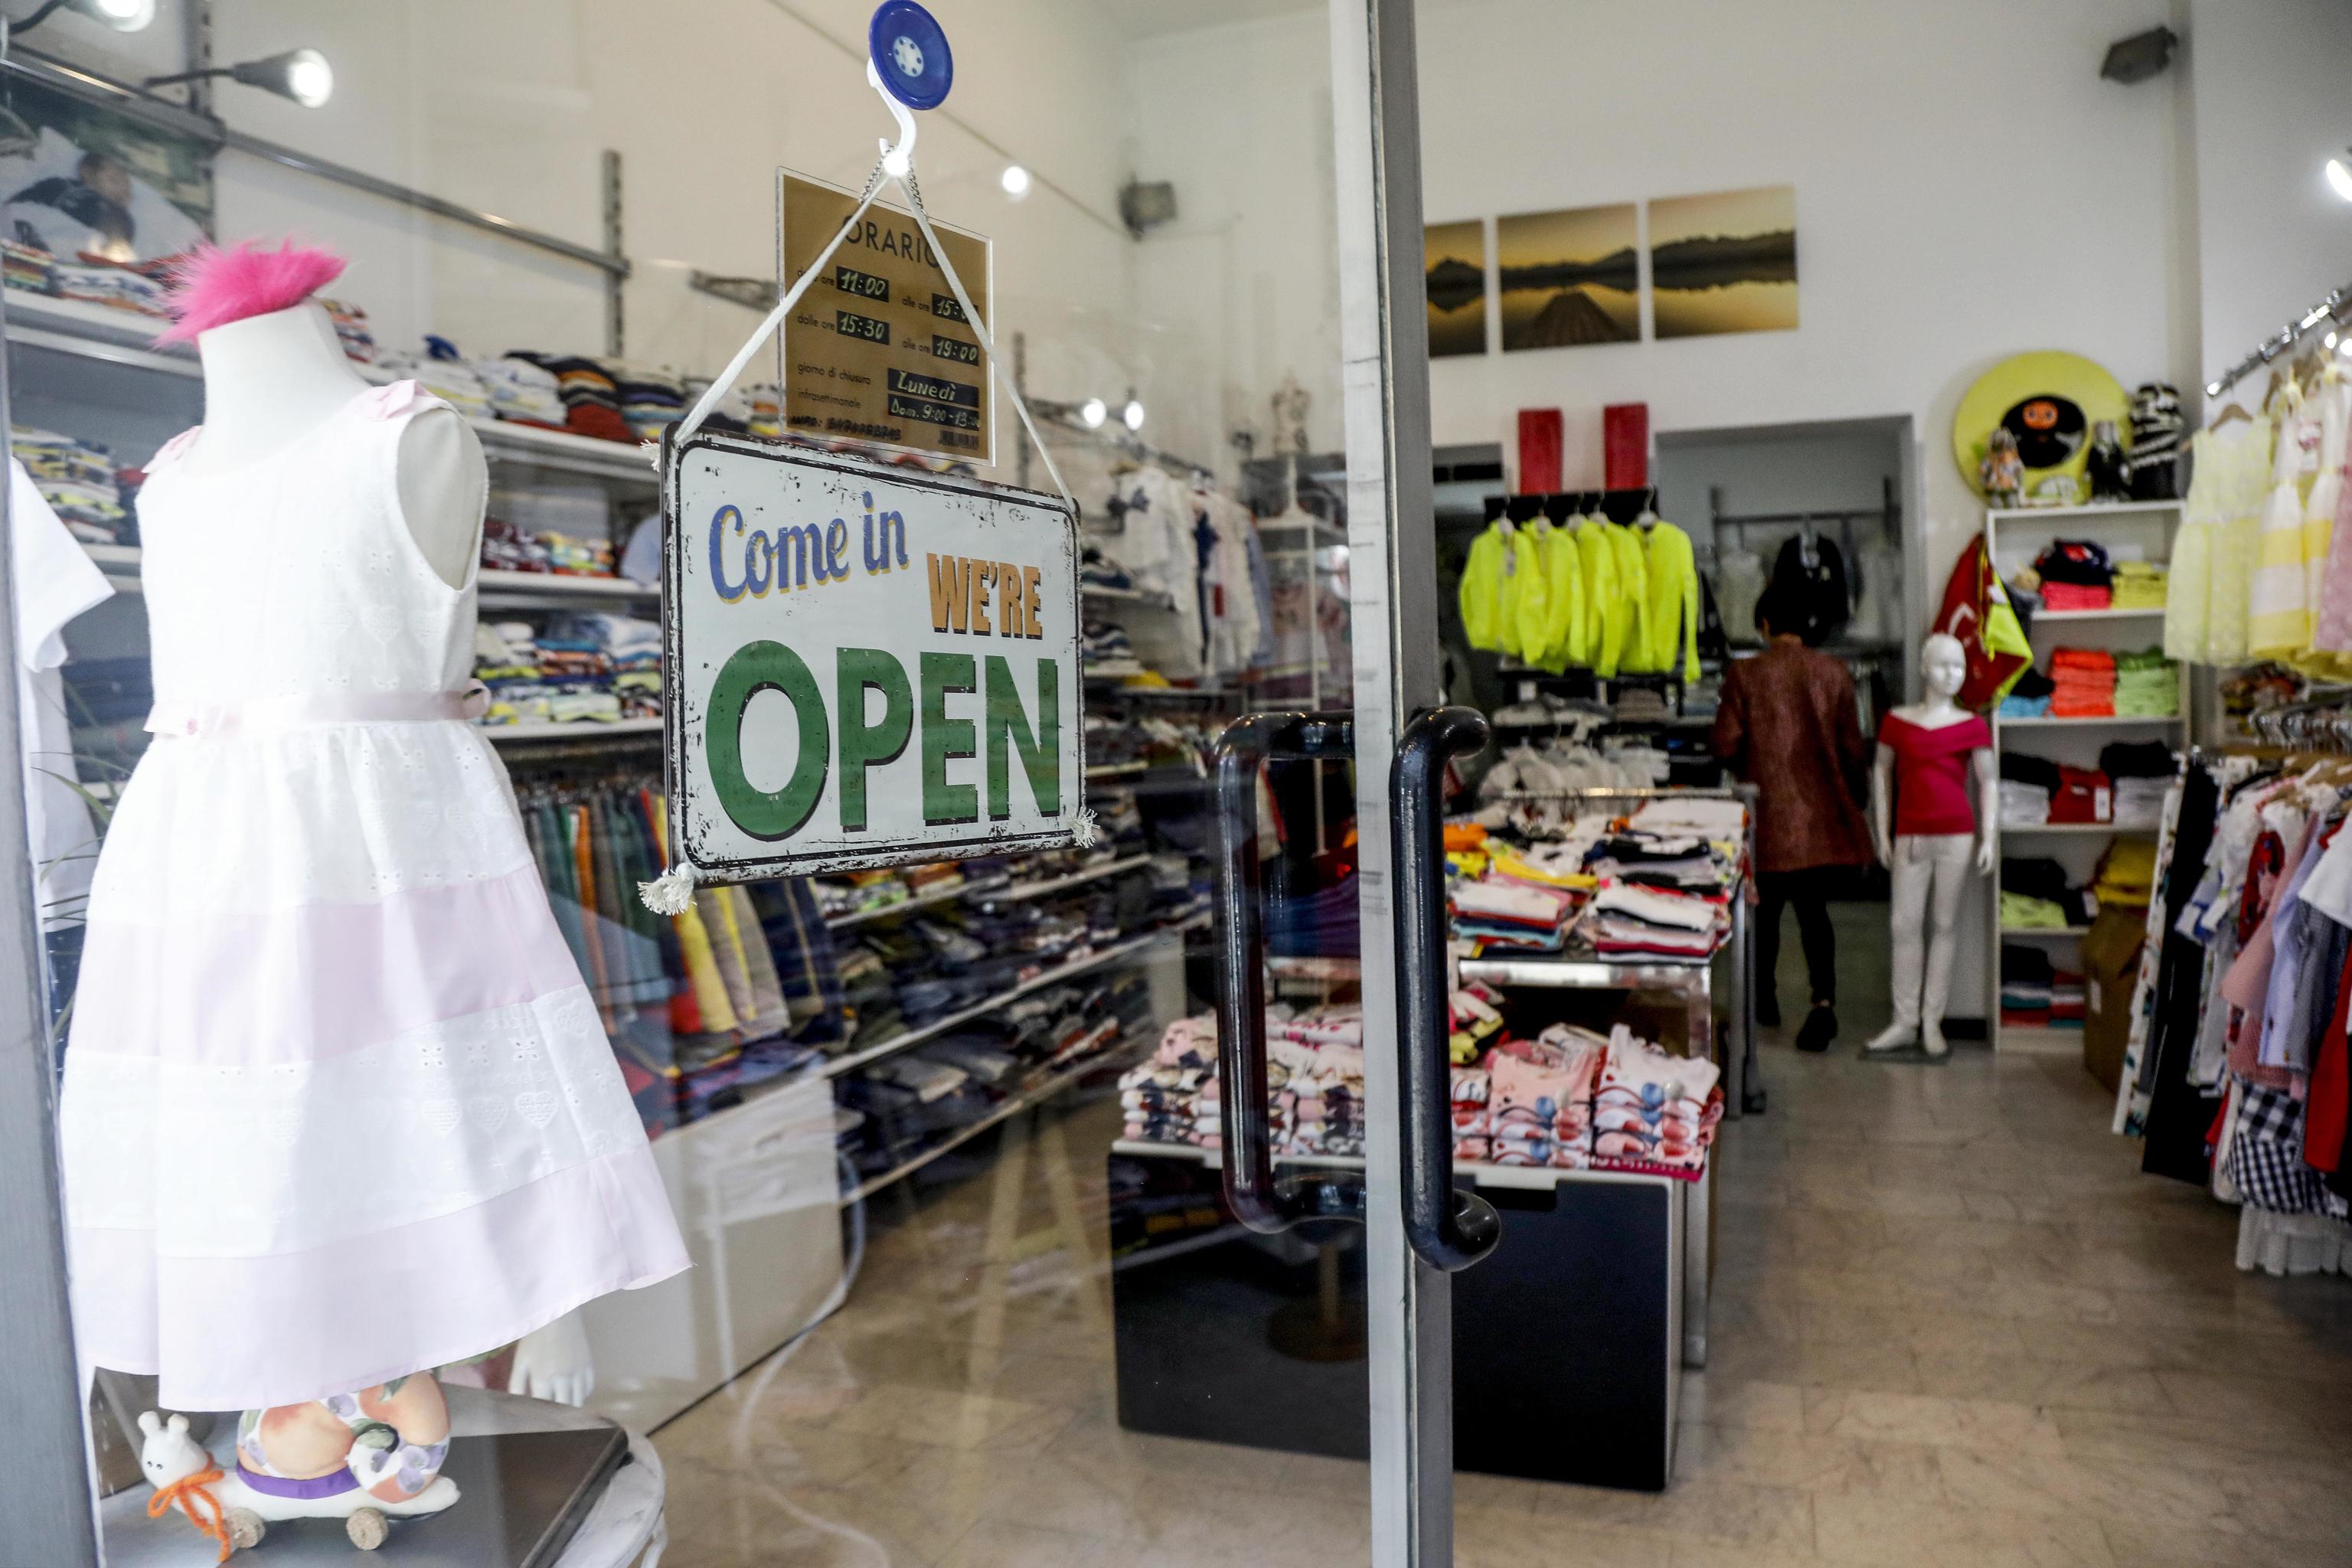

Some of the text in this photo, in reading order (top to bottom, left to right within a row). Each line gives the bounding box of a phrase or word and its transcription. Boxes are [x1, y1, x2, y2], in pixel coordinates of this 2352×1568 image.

[821, 276, 835, 286] ore
[840, 271, 886, 296] 11:00
[902, 296, 916, 308] alle
[918, 302, 931, 312] ore
[797, 312, 978, 361] dalle ore 15:30 alle ore 19:00
[797, 361, 825, 376] giorno
[828, 367, 836, 378] di
[838, 369, 871, 385] chiusura
[709, 491, 910, 605] Come in
[927, 552, 1044, 640] WE'RE
[706, 640, 1061, 841] OPEN
